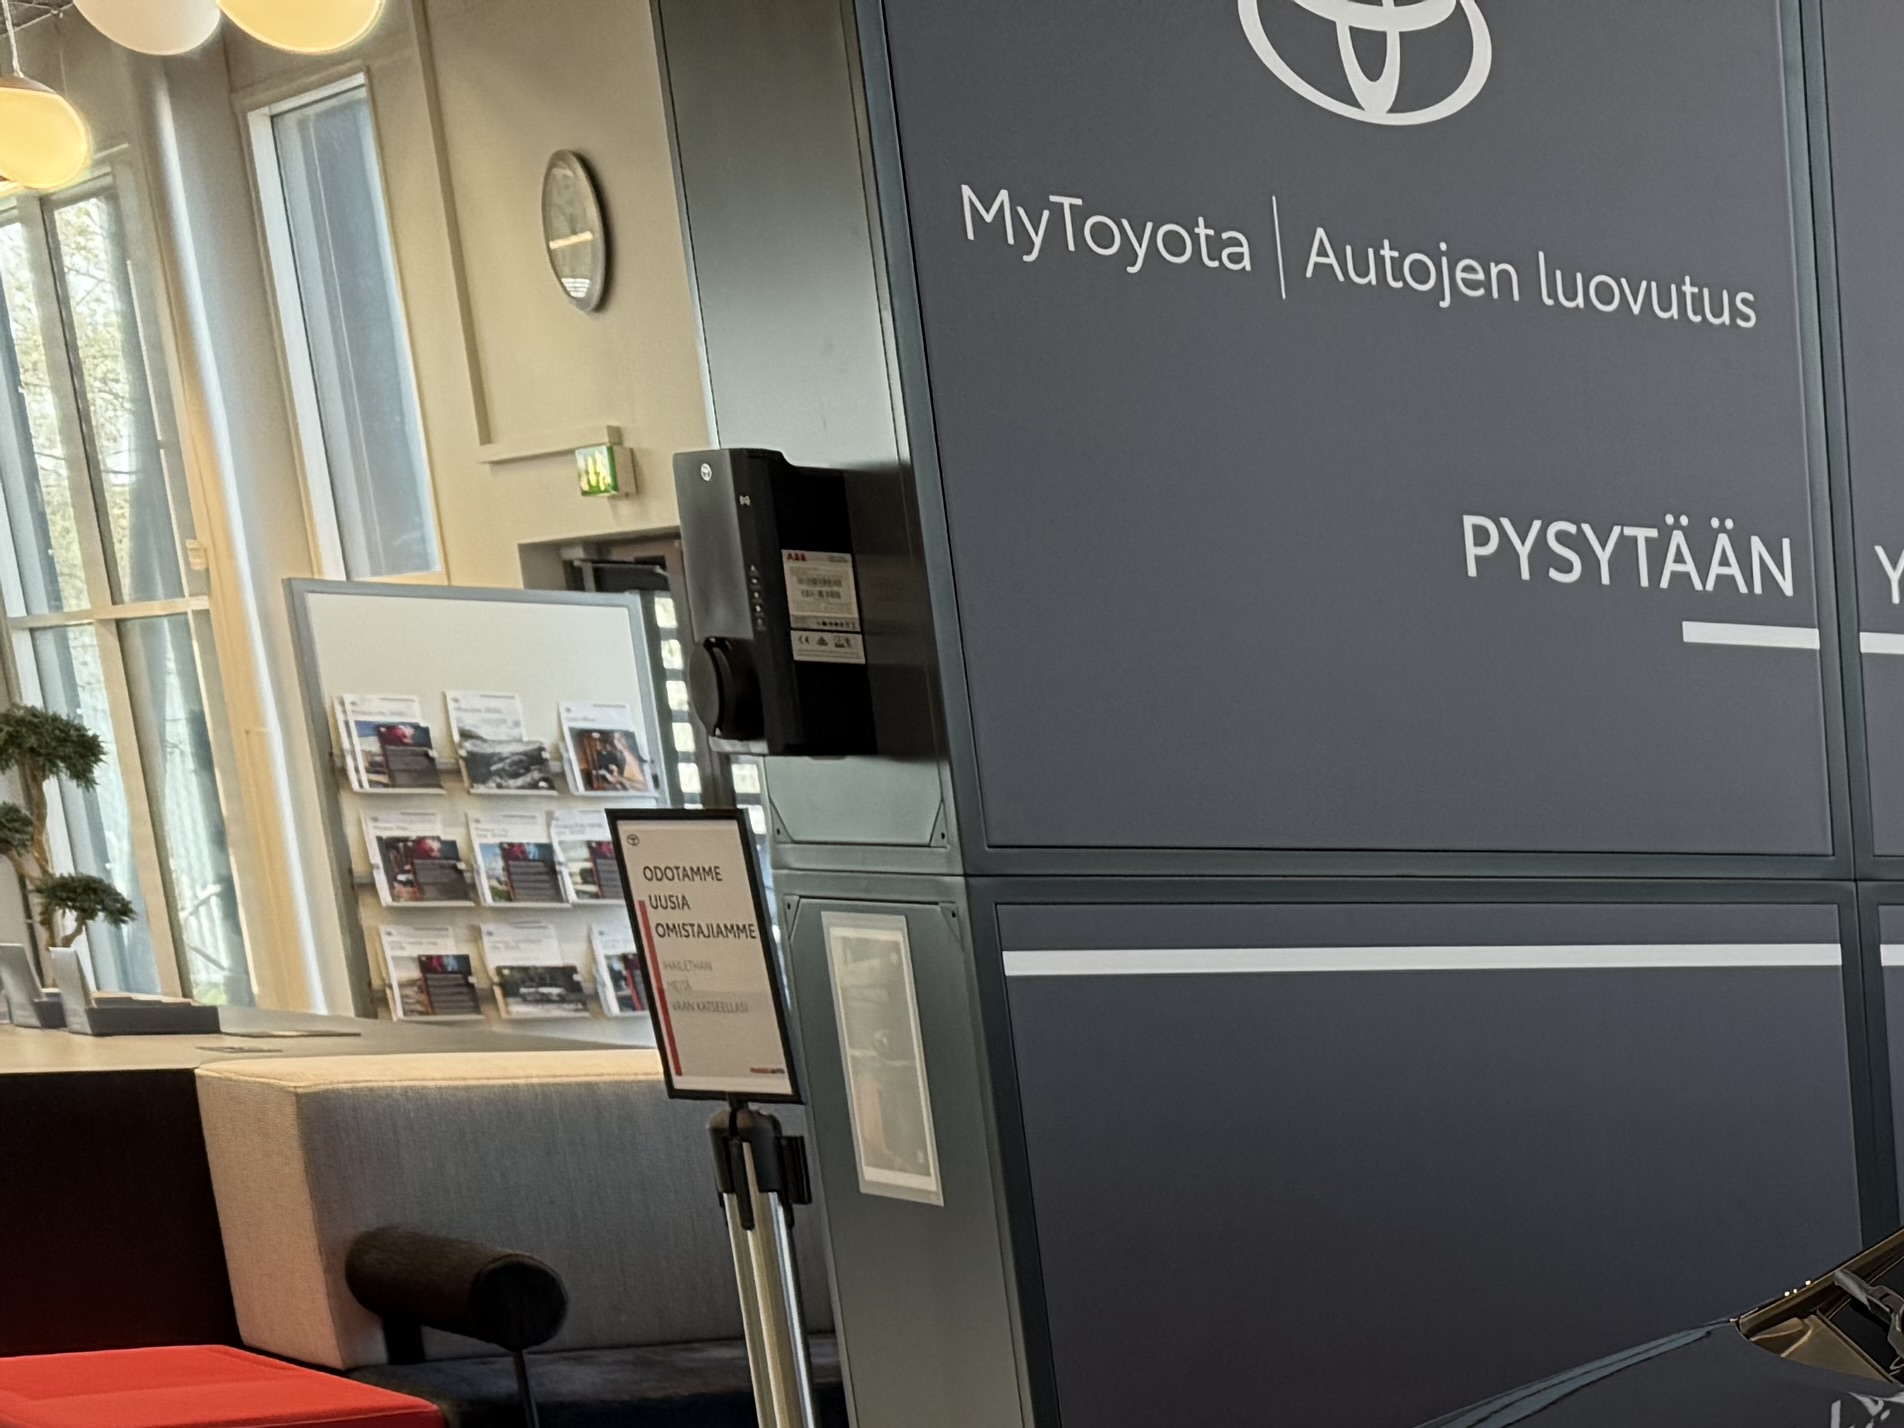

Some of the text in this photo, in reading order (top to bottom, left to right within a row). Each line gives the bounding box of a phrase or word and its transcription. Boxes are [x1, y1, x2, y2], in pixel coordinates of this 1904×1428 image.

[961, 184, 1757, 329] MyToyota Autojen luovutus
[1462, 514, 1794, 597] PYSYTÄÄN
[642, 865, 723, 882] ODOTAMME
[648, 894, 691, 911] UUSIA
[655, 922, 757, 940] OMISTAJIAMME
